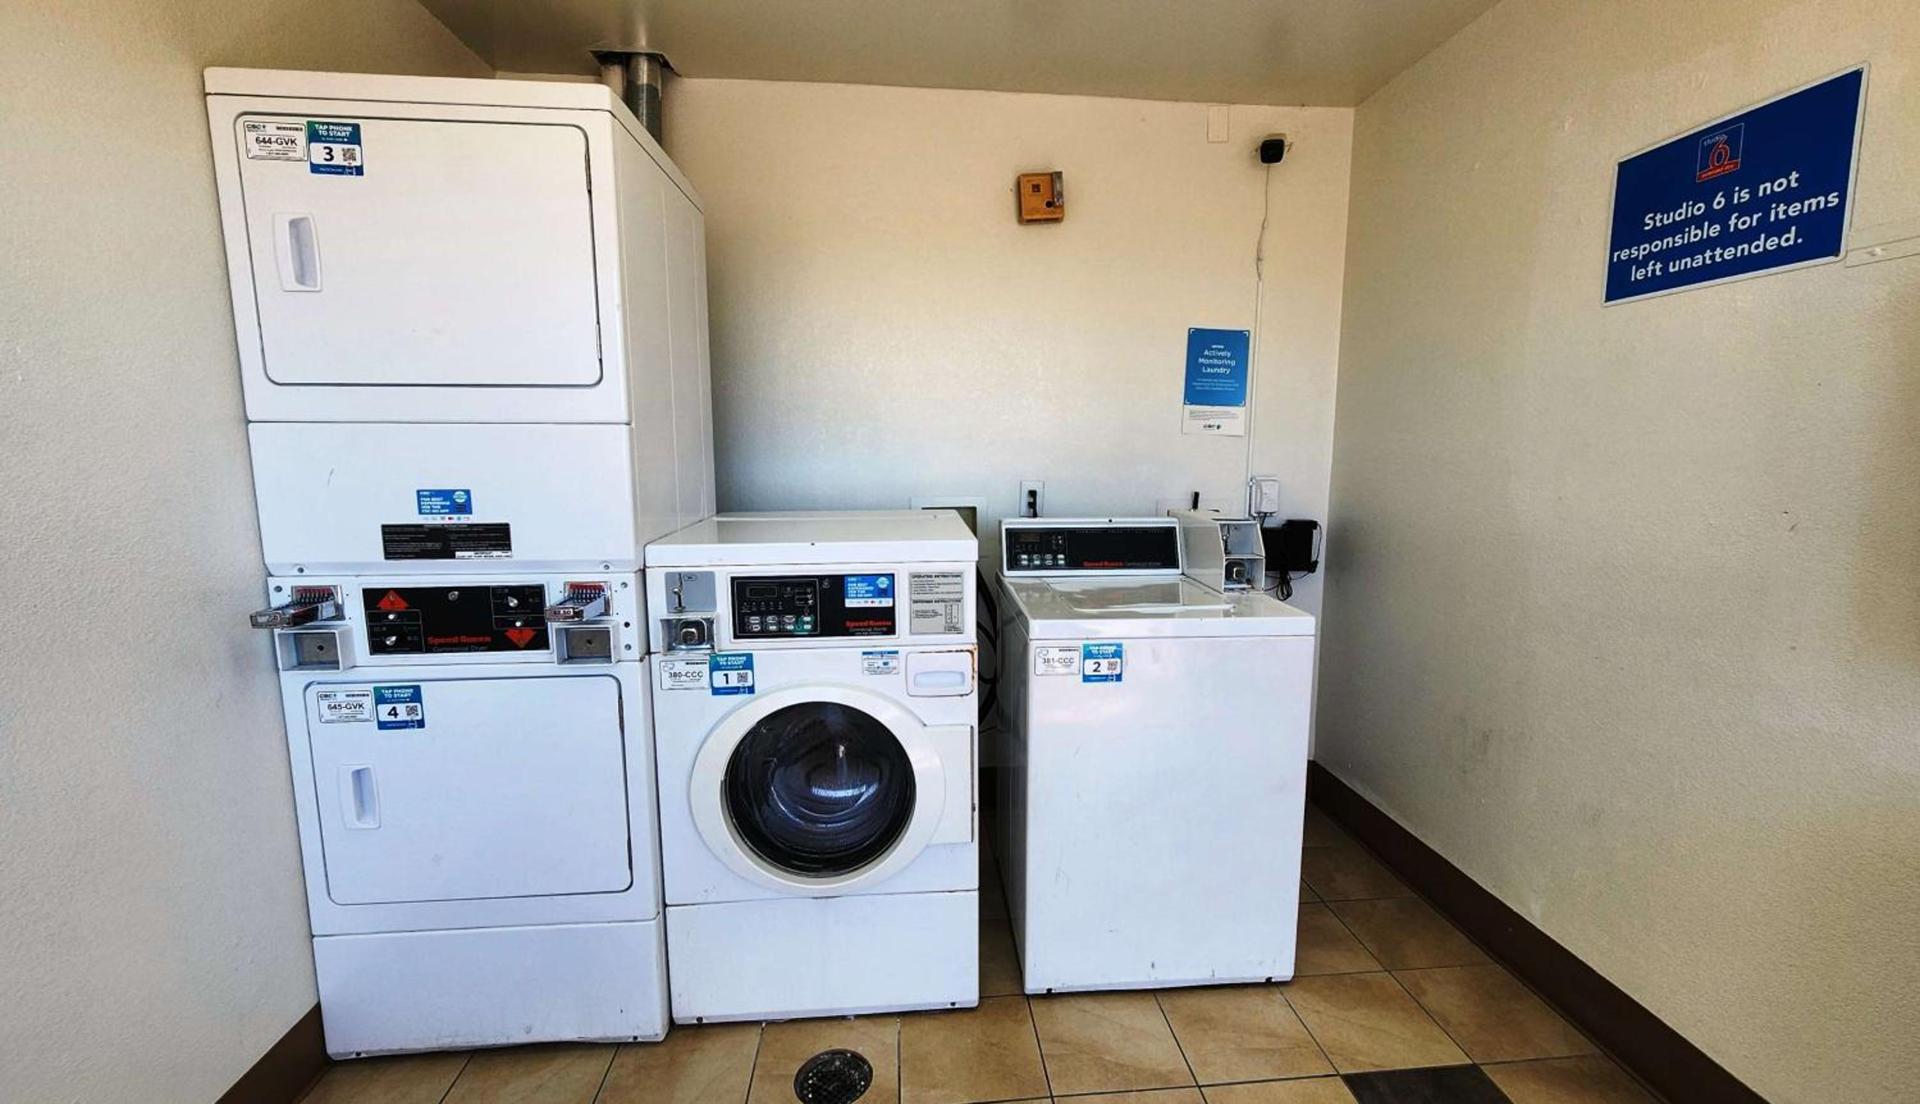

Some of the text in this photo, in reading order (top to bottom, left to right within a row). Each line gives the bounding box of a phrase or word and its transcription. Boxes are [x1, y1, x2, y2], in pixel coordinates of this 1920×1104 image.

[255, 136, 298, 147] 644-GVK
[323, 146, 334, 162] 3
[1643, 200, 1705, 231] Studio
[1712, 191, 1725, 210] 6
[1733, 186, 1750, 204] is
[1758, 170, 1800, 197] not
[1612, 191, 1840, 263] responsible for items
[1630, 227, 1803, 282] left unattended.
[1203, 349, 1231, 358] Actively
[1198, 358, 1236, 367] Monitoring
[1202, 366, 1231, 375] Laundry
[1092, 661, 1101, 673] 2
[723, 673, 729, 685] 1
[327, 702, 365, 711] 645-GVK
[387, 706, 399, 719] 4
